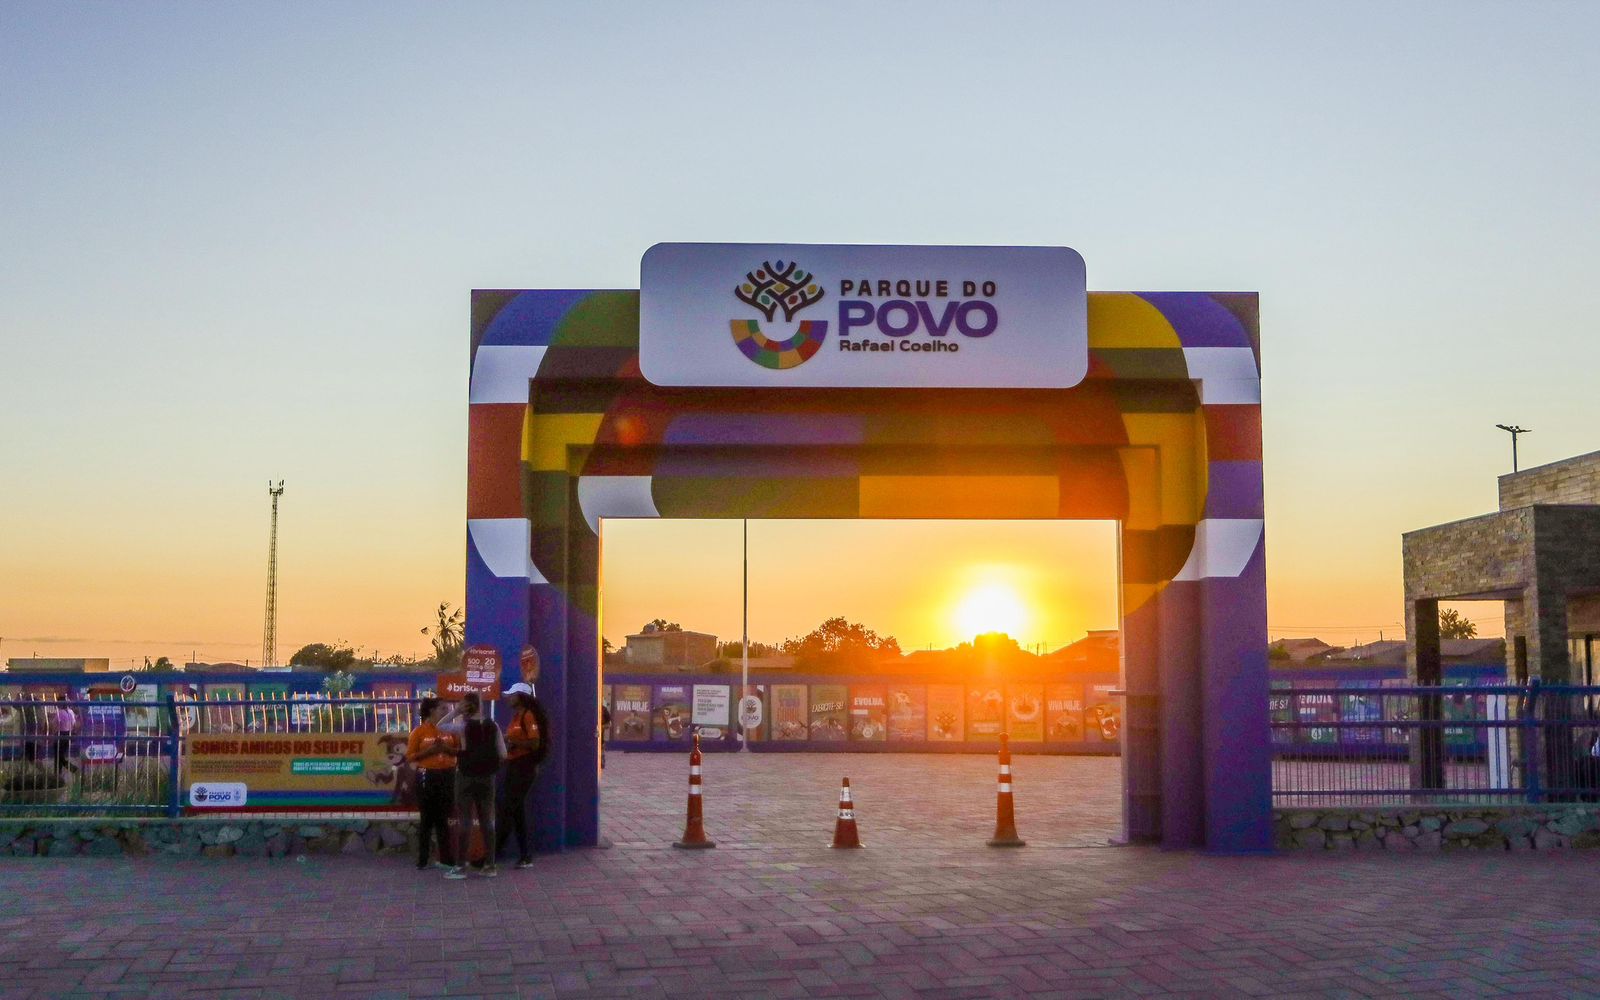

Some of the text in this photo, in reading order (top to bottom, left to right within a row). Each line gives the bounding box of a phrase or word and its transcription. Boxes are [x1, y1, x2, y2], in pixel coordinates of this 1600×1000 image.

[840, 279, 996, 297] PARQUE DO
[838, 300, 999, 338] POVO
[839, 339, 959, 352] Rafael Coelho
[484, 657, 496, 666] 20
[192, 740, 365, 755] SOMOS AMIGOS DO SEU PET
